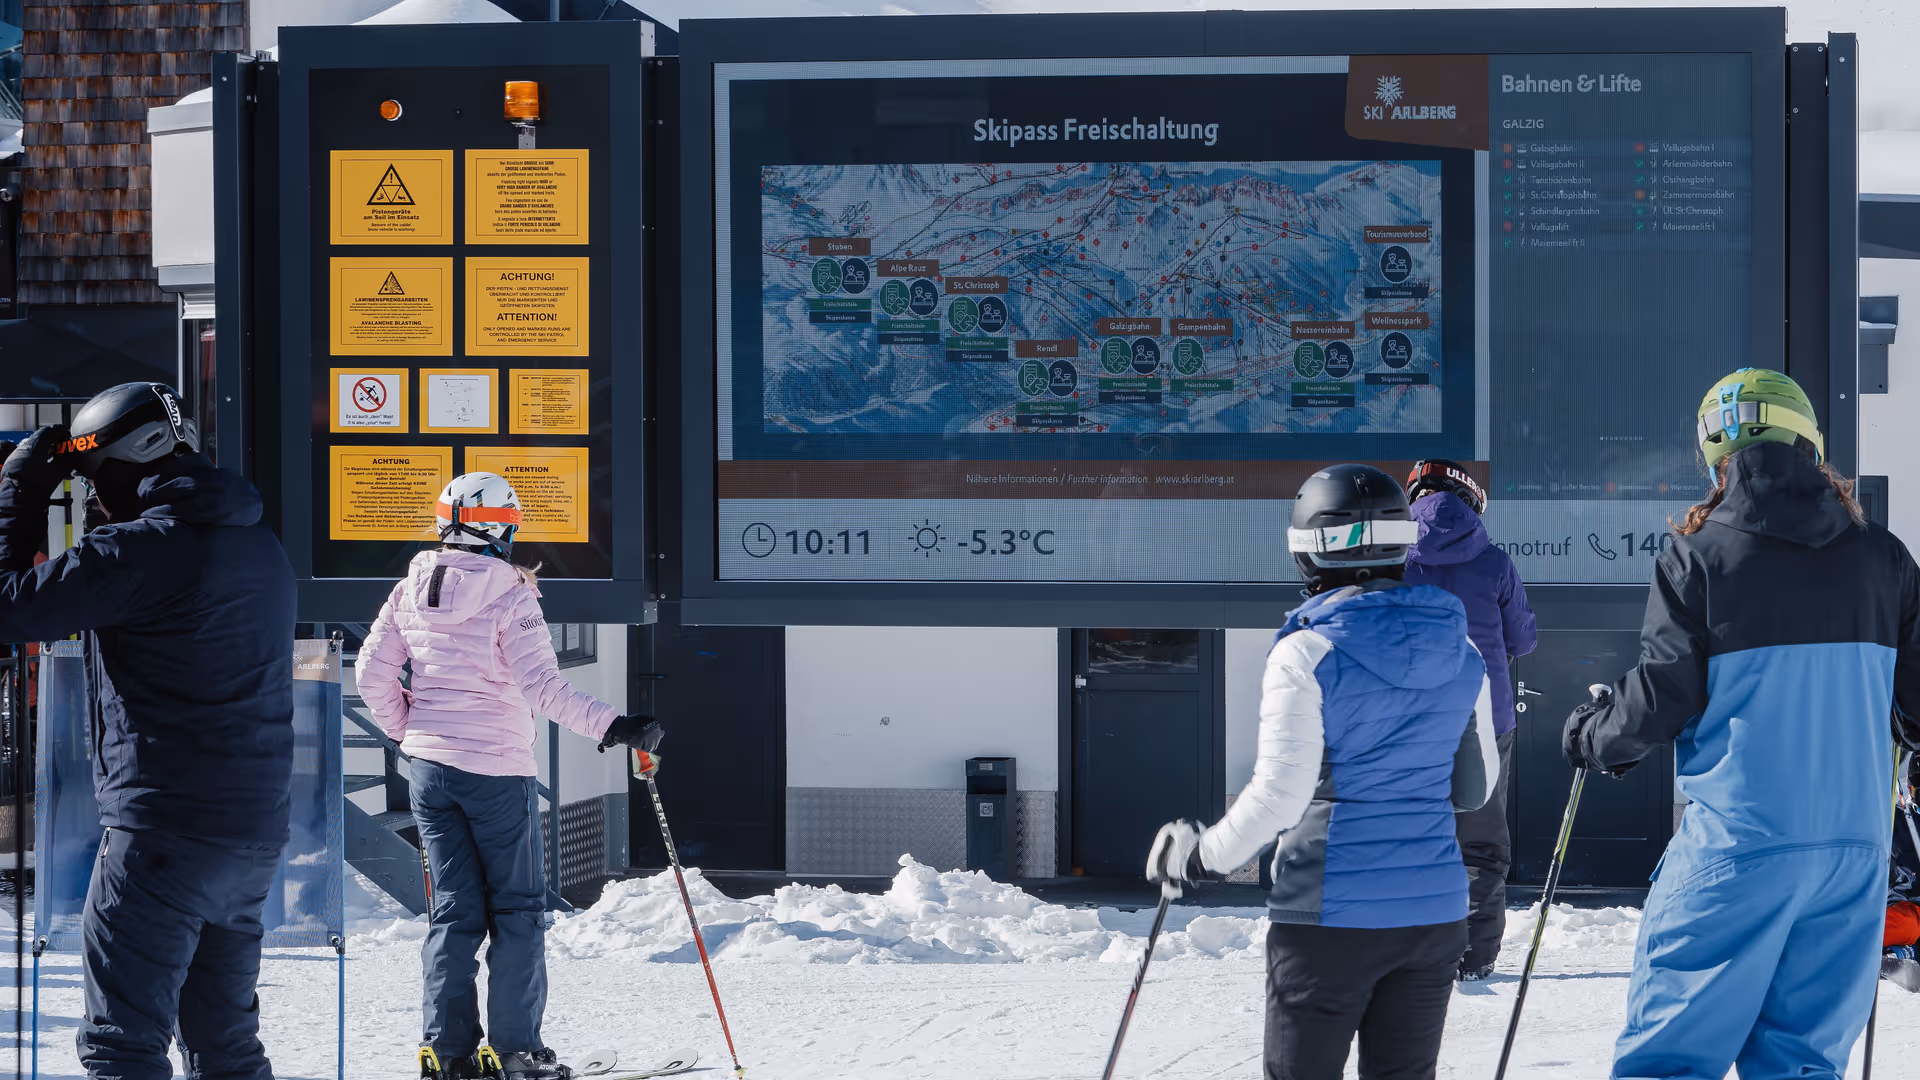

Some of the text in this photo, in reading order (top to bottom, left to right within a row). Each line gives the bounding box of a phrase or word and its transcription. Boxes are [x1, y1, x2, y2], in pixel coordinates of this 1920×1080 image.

[1502, 73, 1642, 93] Bahnen & Lifte
[1364, 105, 1457, 120] SKI ARLBERG
[1502, 118, 1545, 129] GALZIG
[974, 116, 1219, 148] Skipass Freischaltung
[1530, 143, 1574, 154] Galzigbahn
[1662, 143, 1710, 154] Vallugabahn
[1530, 159, 1578, 169] Vallugabahn
[1662, 175, 1715, 185] Osthangbahn
[1366, 230, 1427, 239] Tourismusverband
[827, 242, 853, 251] Stuben
[890, 264, 926, 274] Alpe Rauz
[500, 272, 555, 281] ACHTUNG!
[953, 281, 1000, 291] St. Christoph
[497, 313, 557, 321] ATTENTION!
[1371, 316, 1422, 326] Wellnesspark
[1109, 322, 1151, 332] Galzigbahn
[1178, 323, 1226, 333] Gampenbahn
[1296, 326, 1350, 334] Nassereinbahn
[1036, 344, 1058, 352] Rendl
[966, 473, 997, 484] Nähere
[998, 473, 1058, 484] Informationen
[1067, 473, 1099, 484] Further
[1100, 473, 1148, 486] information
[1155, 473, 1235, 486] www.skiarlberg.at
[1446, 467, 1477, 492] ULLER
[786, 529, 1055, 556] 10:11 -5.3°C
[1488, 537, 1571, 556] nnotruf
[652, 793, 668, 828] LEKI
